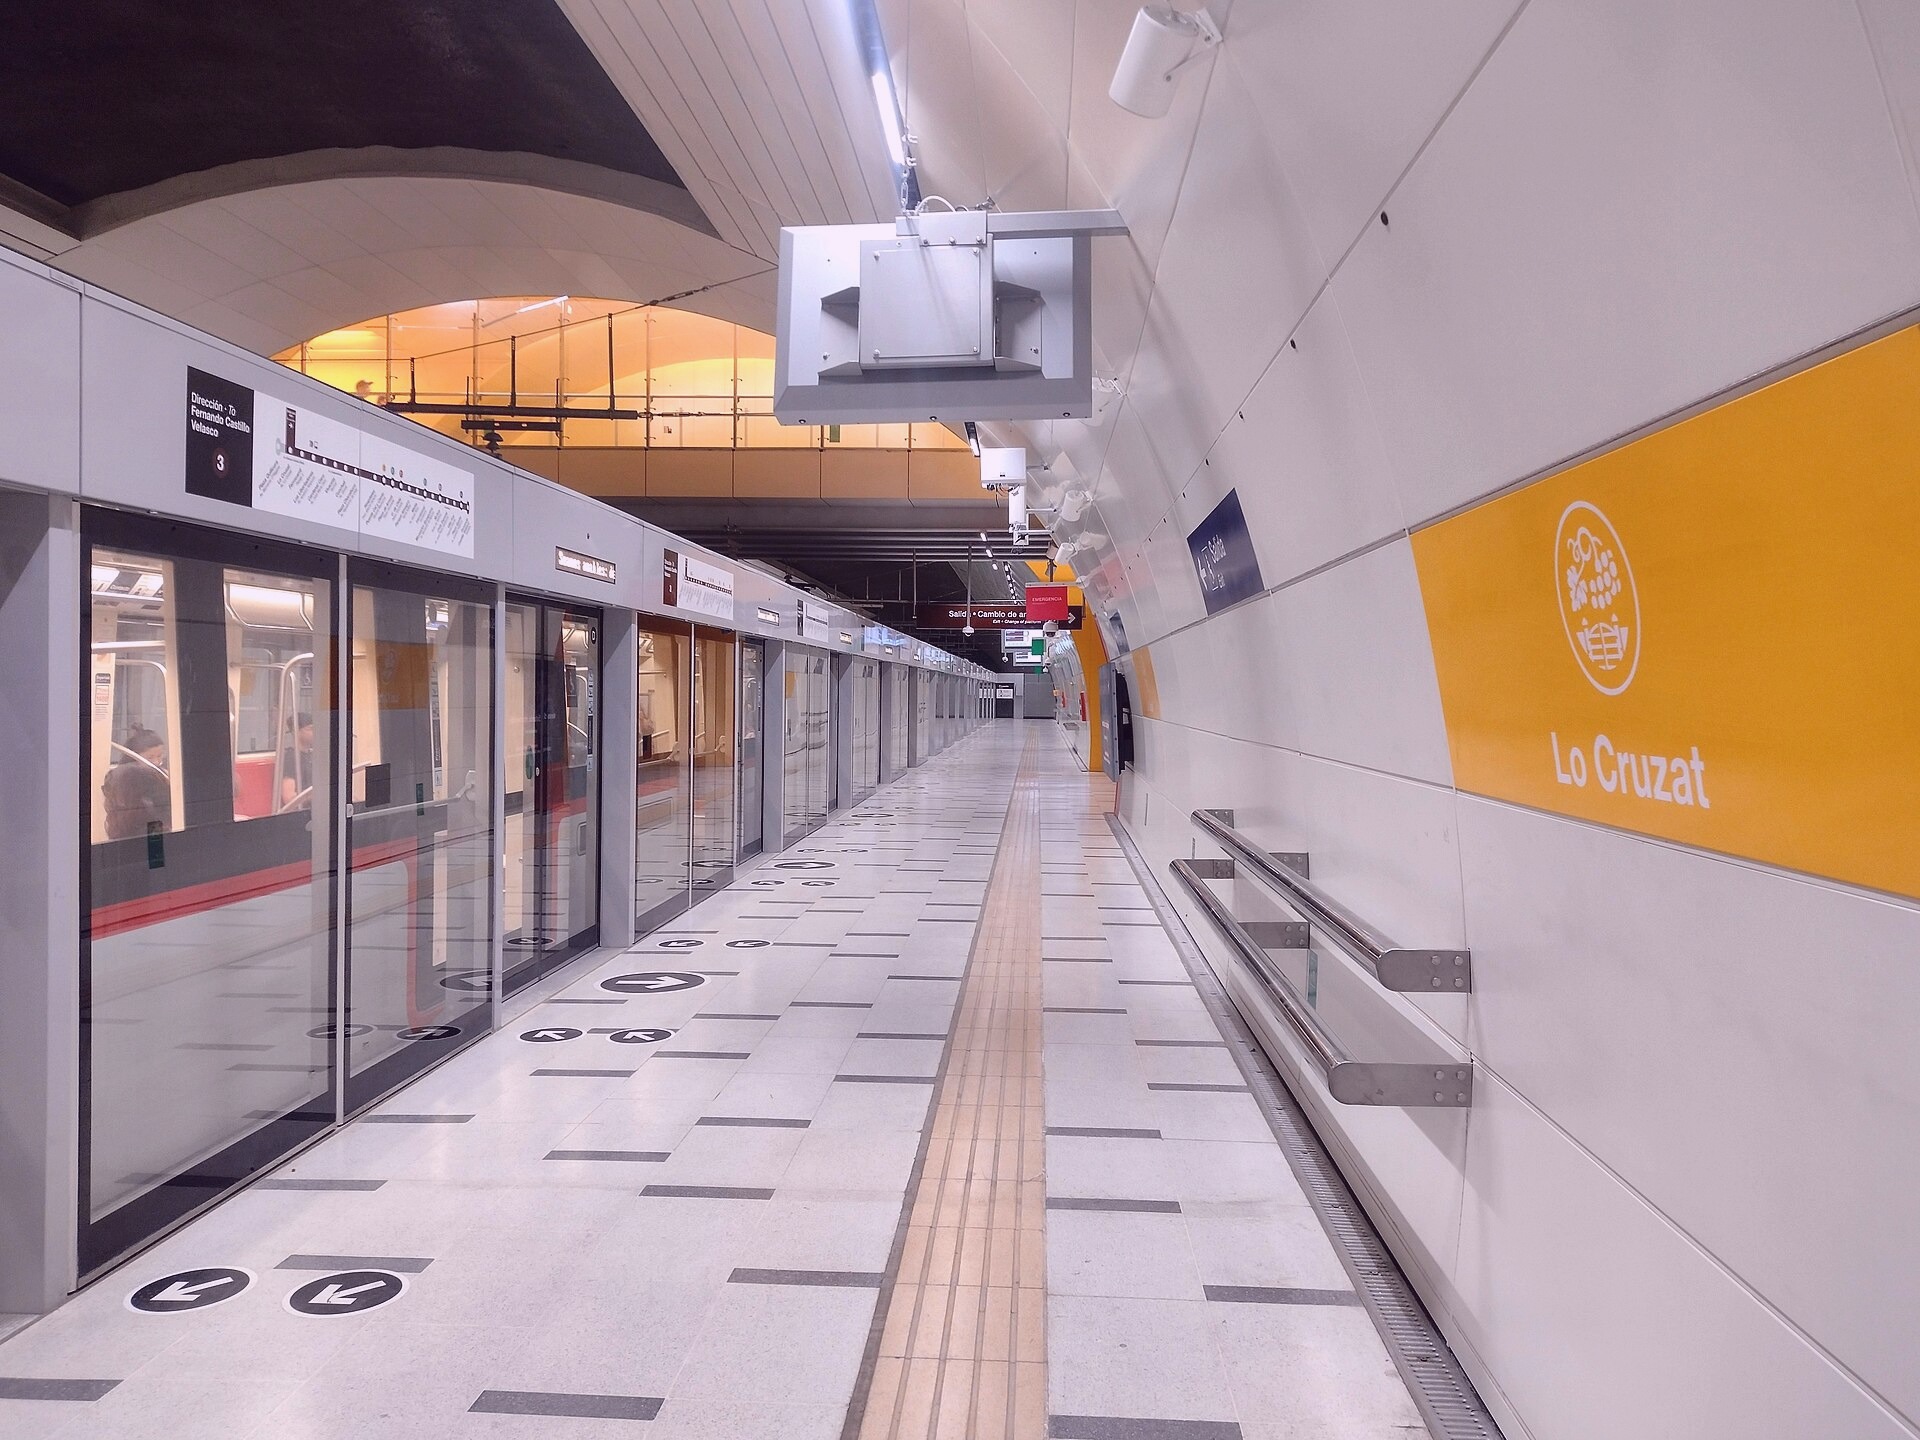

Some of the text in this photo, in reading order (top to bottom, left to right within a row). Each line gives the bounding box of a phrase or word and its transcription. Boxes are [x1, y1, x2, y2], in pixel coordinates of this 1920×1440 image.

[191, 391, 236, 416] Dirección To
[190, 419, 219, 437] Velasco
[191, 405, 251, 433] Fernando Castillo
[216, 454, 224, 471] 3
[977, 610, 1006, 618] Cambio
[1007, 610, 1018, 618] de
[1550, 731, 1711, 809] Lo Cruzat
